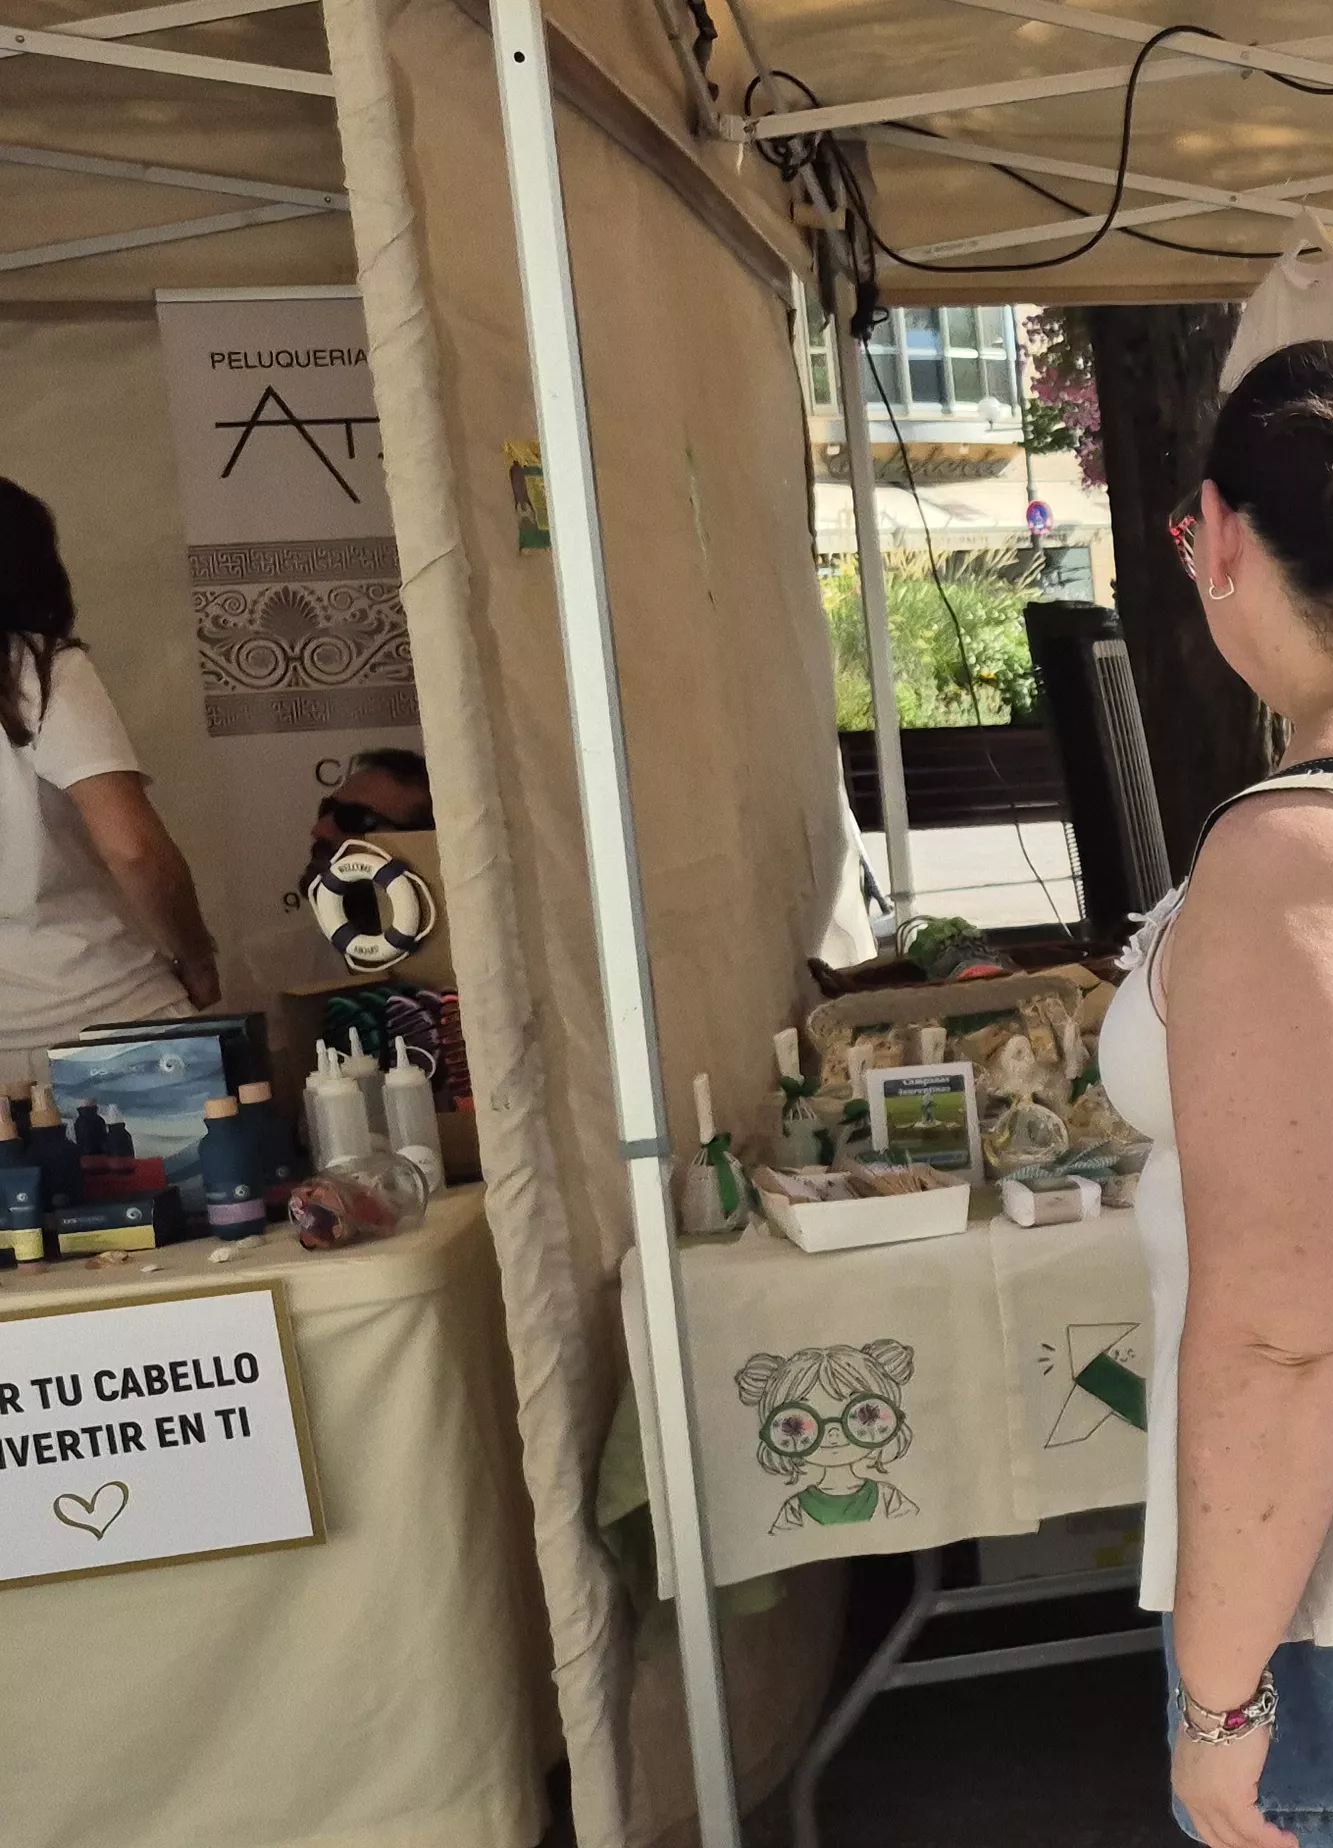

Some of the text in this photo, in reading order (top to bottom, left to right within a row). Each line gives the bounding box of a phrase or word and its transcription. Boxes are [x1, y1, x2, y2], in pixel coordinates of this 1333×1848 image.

[211, 348, 368, 370] PELUQUERIA
[31, 1373, 83, 1410] TU
[94, 1352, 260, 1402] CABELLO
[155, 1412, 206, 1448] EN
[214, 1406, 251, 1440] TI
